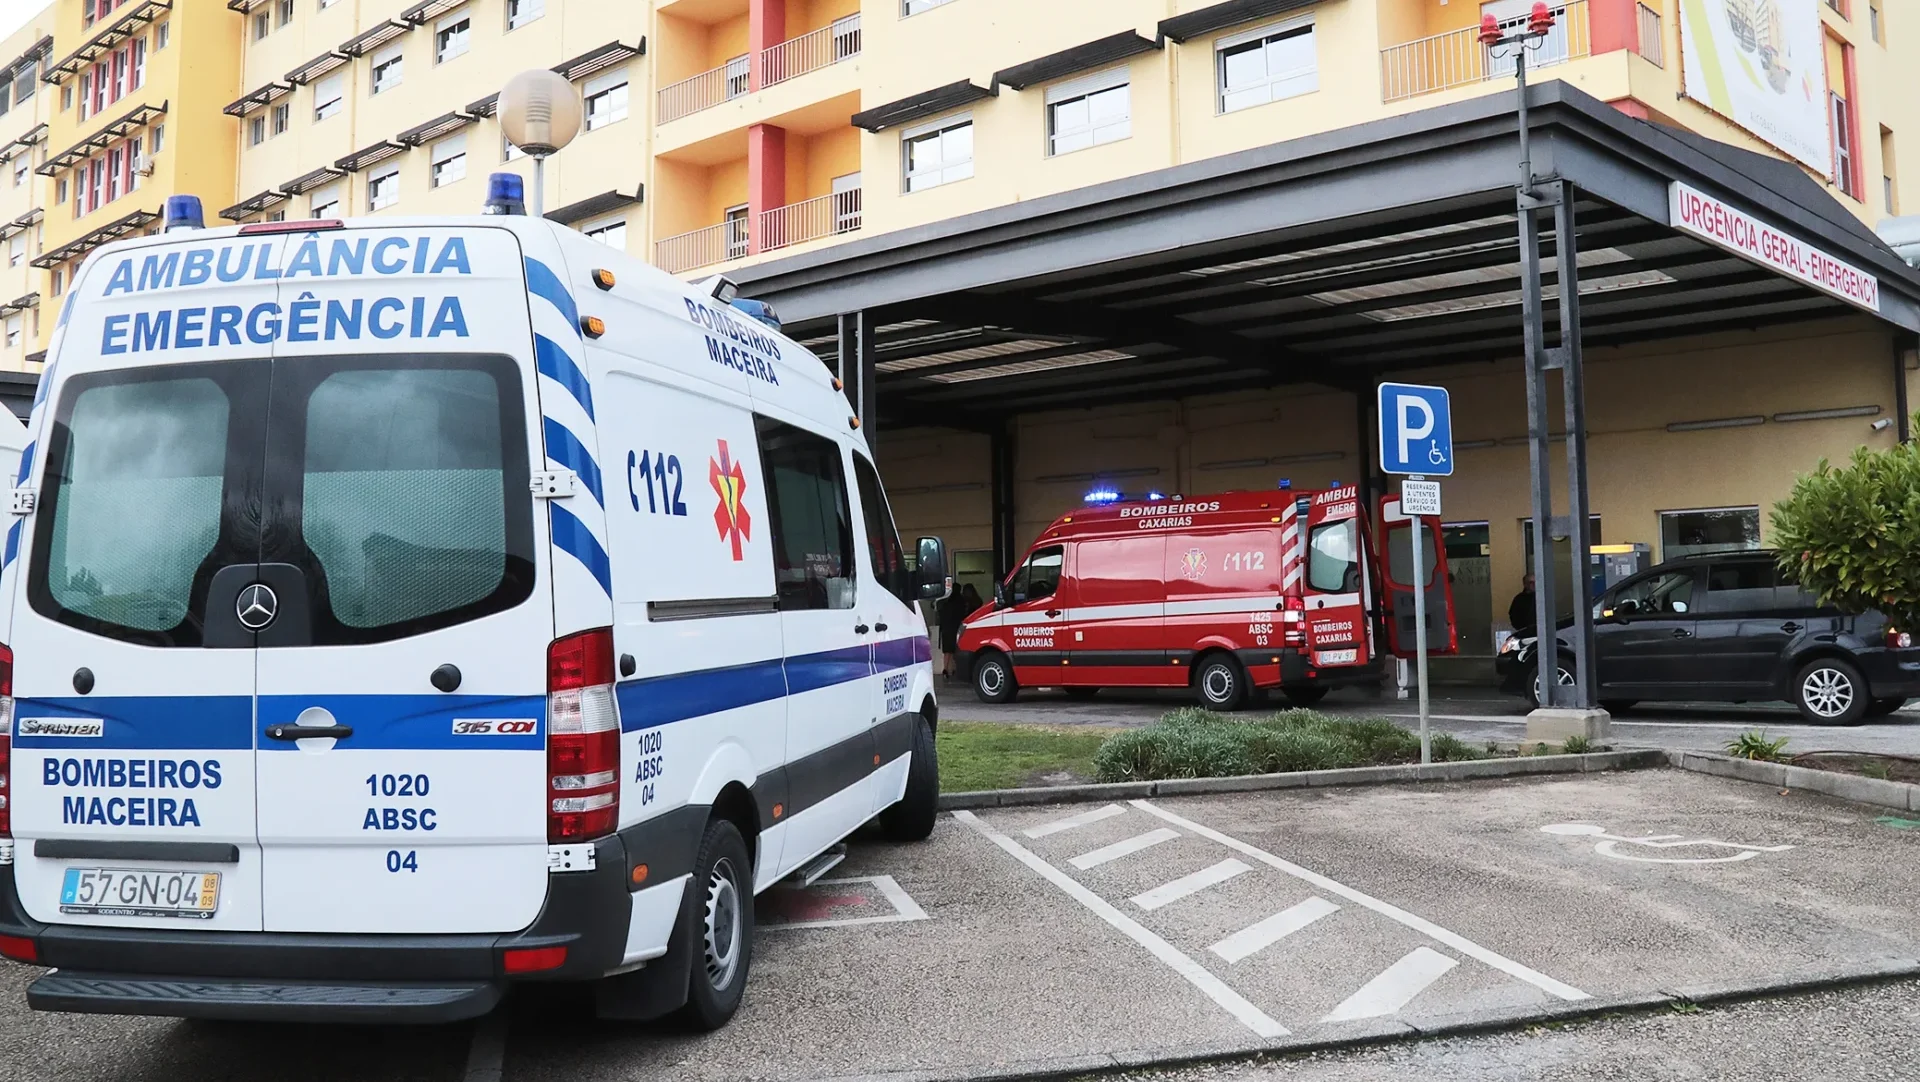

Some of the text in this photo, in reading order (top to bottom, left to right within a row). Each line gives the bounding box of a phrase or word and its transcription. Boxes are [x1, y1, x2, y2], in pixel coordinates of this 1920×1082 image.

[1679, 189, 1759, 254] URGÊNCIA
[103, 231, 472, 297] AMBULÂNCIA
[101, 291, 470, 356] EMERGÊNCIA
[683, 296, 781, 361] BOMBEIROS
[704, 334, 780, 387] MACEIRA
[1396, 394, 1435, 464] P
[639, 449, 688, 517] 112
[1315, 486, 1356, 506] AMBUL
[1120, 501, 1220, 518] BOMBEIROS
[1326, 502, 1356, 517] EMERG
[1138, 516, 1192, 529] CAXARIAS
[1231, 551, 1265, 571] 112
[1250, 612, 1271, 622] 1425
[1313, 621, 1353, 633] BOMBEIROS
[1013, 626, 1055, 636] BOMBEIROS
[1248, 623, 1273, 635] ABSC
[1256, 634, 1268, 646] 03
[1315, 632, 1353, 644] CAXARIAS
[1015, 638, 1054, 648] CAXARIAS
[883, 672, 908, 695] BOMBEIROS
[454, 721, 536, 734] 315 CDI
[638, 730, 662, 756] 1020
[42, 757, 222, 789] BOMBEIROS
[635, 755, 663, 783] ABSC
[366, 773, 430, 797] 1020
[642, 782, 655, 806] 04
[62, 796, 201, 827] MACEIRA
[362, 808, 437, 831] ABSC
[386, 850, 418, 873] 04
[203, 878, 215, 889] 08
[201, 896, 213, 906] 09
